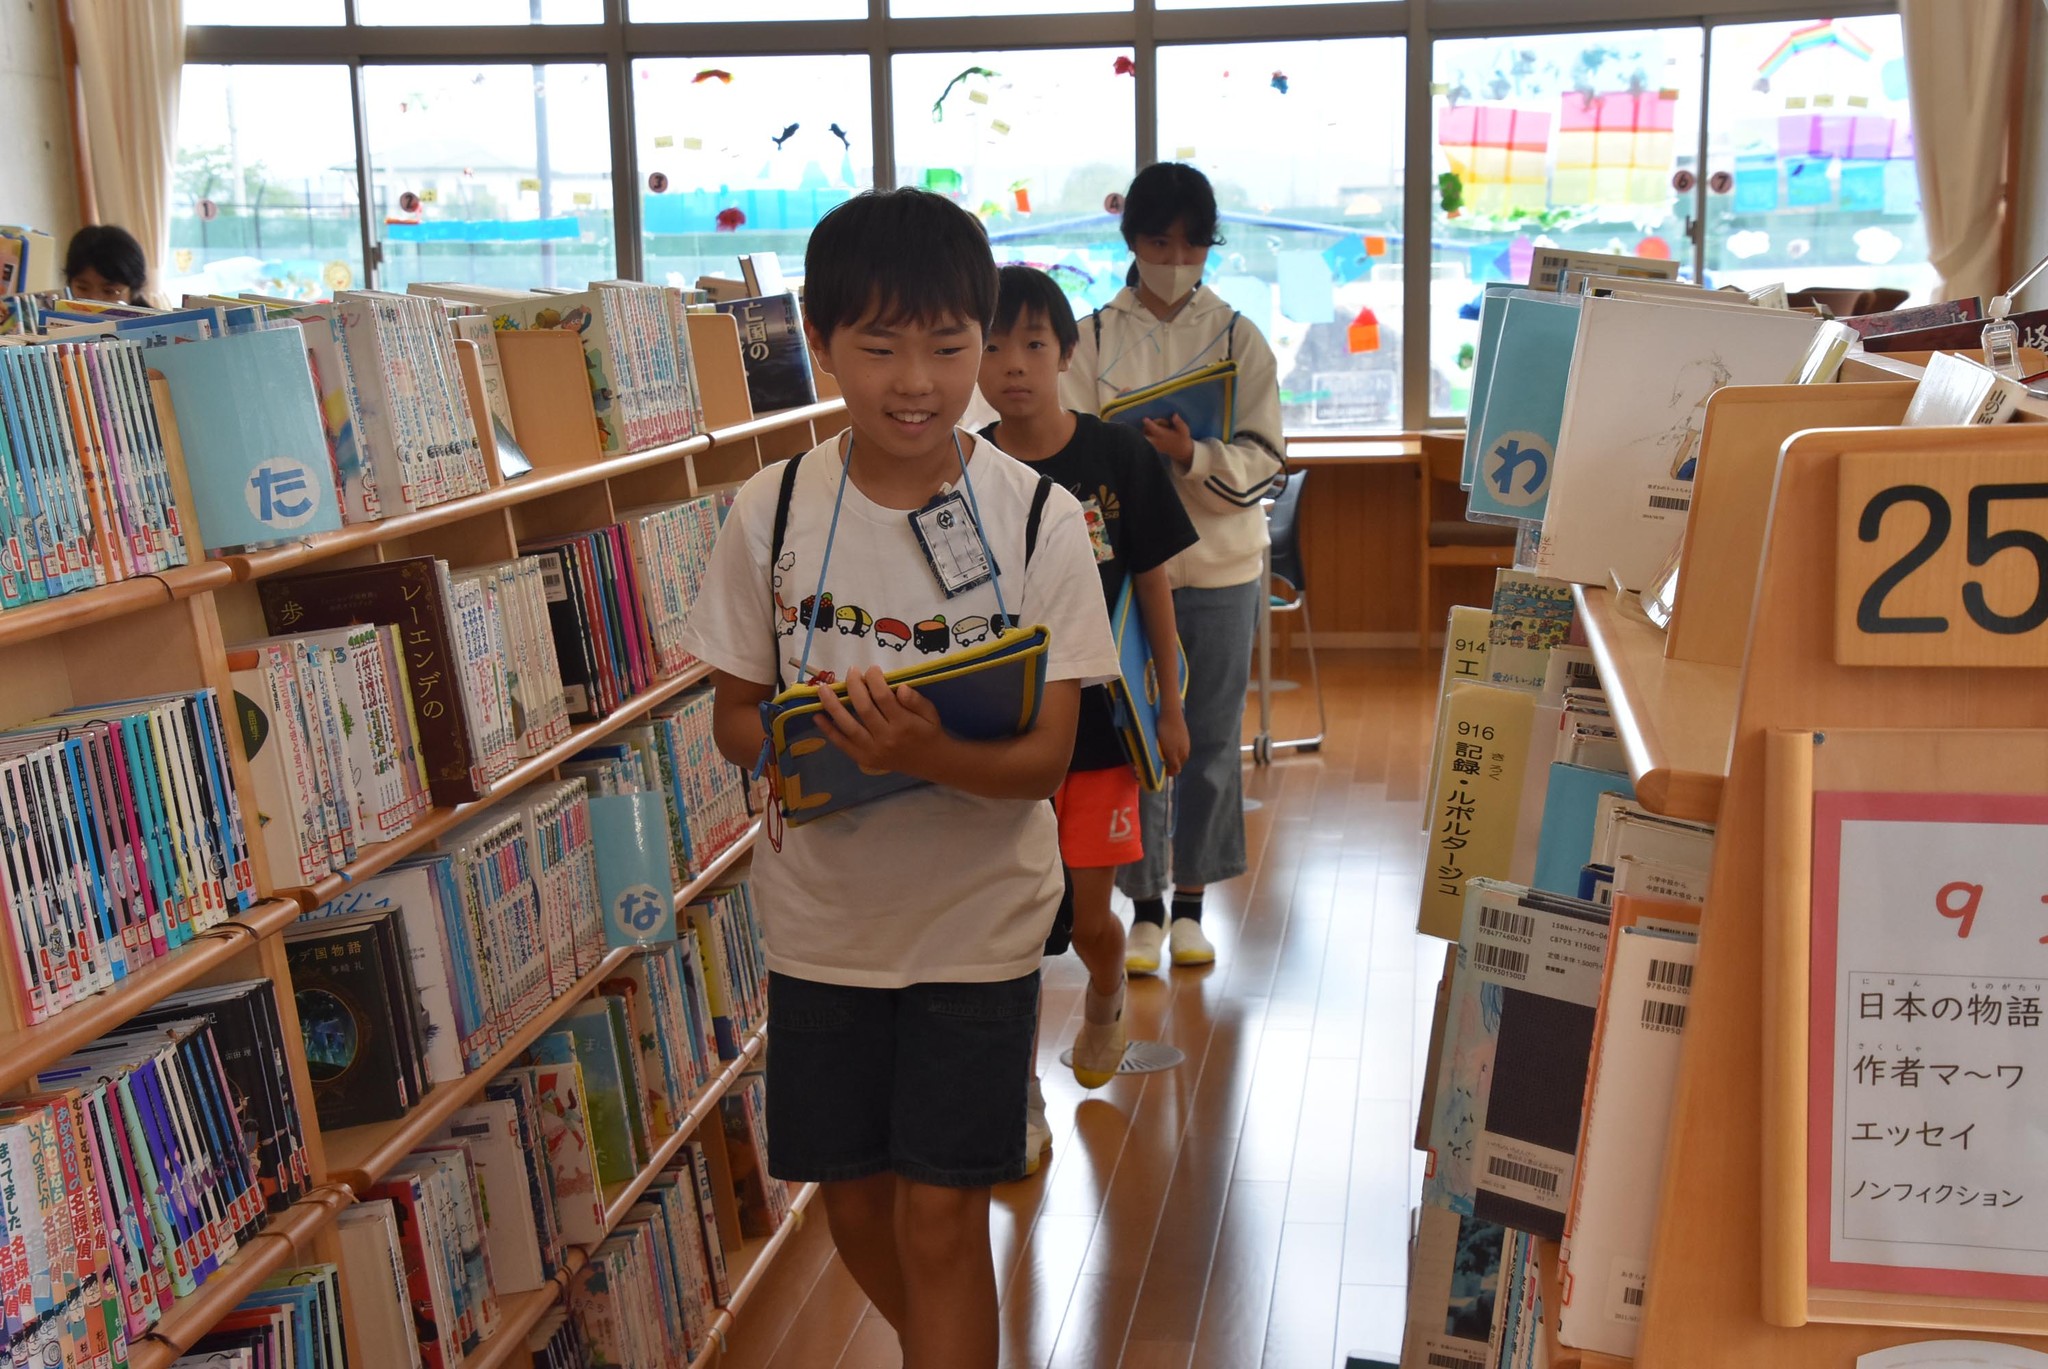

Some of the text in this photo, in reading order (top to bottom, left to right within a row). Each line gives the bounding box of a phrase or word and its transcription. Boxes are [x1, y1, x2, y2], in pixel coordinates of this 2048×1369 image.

[742, 303, 770, 360] 亡国の
[1490, 439, 1548, 495] わ
[250, 466, 314, 522] た
[1856, 482, 2048, 635] 25
[281, 600, 304, 626] 歩
[401, 584, 445, 719] レーエンデの
[1455, 638, 1486, 655] 914
[1455, 659, 1479, 676] エ
[1457, 721, 1494, 741] 916
[1438, 741, 1483, 896] 記録・ルポルタージュ
[619, 890, 661, 931] な
[1936, 881, 1983, 939] 9
[1478, 927, 1532, 945] 9784774606743
[1862, 978, 1921, 988] にほん
[1970, 982, 2041, 992] ものがたり
[1860, 991, 2044, 1028] 日本の物語
[1858, 1042, 1922, 1053] さくしゃ
[1851, 1121, 1976, 1151] エッセイ
[28, 1123, 62, 1283] いつのまにか 名探偵
[42, 1113, 75, 1273] しあわせなら 名探偵
[57, 1106, 92, 1260] あめあがりの 名探偵
[1850, 1180, 2023, 1208] ノンフィクション
[0, 1141, 22, 1231] まってました
[11, 1235, 32, 1307] 名探偵
[0, 1247, 20, 1317] 名探偵
